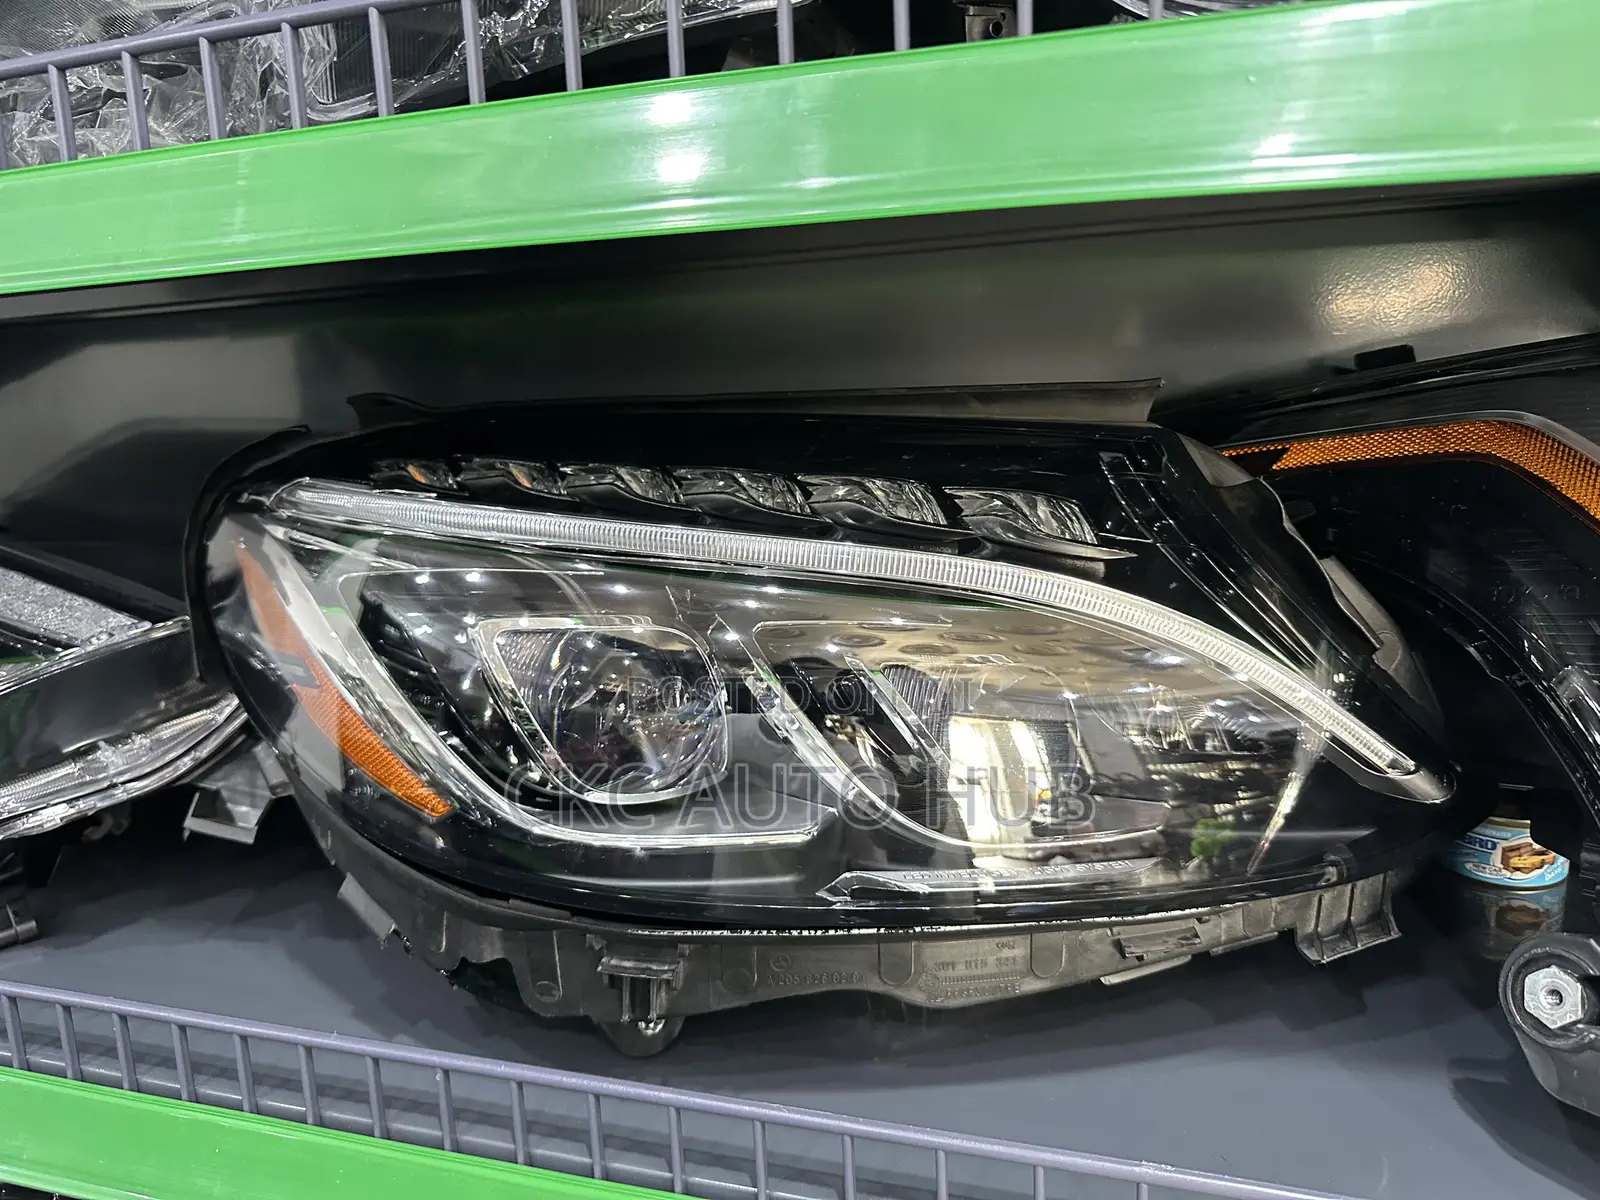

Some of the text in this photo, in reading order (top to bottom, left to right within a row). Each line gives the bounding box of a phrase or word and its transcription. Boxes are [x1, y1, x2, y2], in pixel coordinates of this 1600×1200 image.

[902, 870, 932, 880] LED
[1029, 863, 1073, 876] LIGHT
[1073, 859, 1135, 873] SYSTEM
